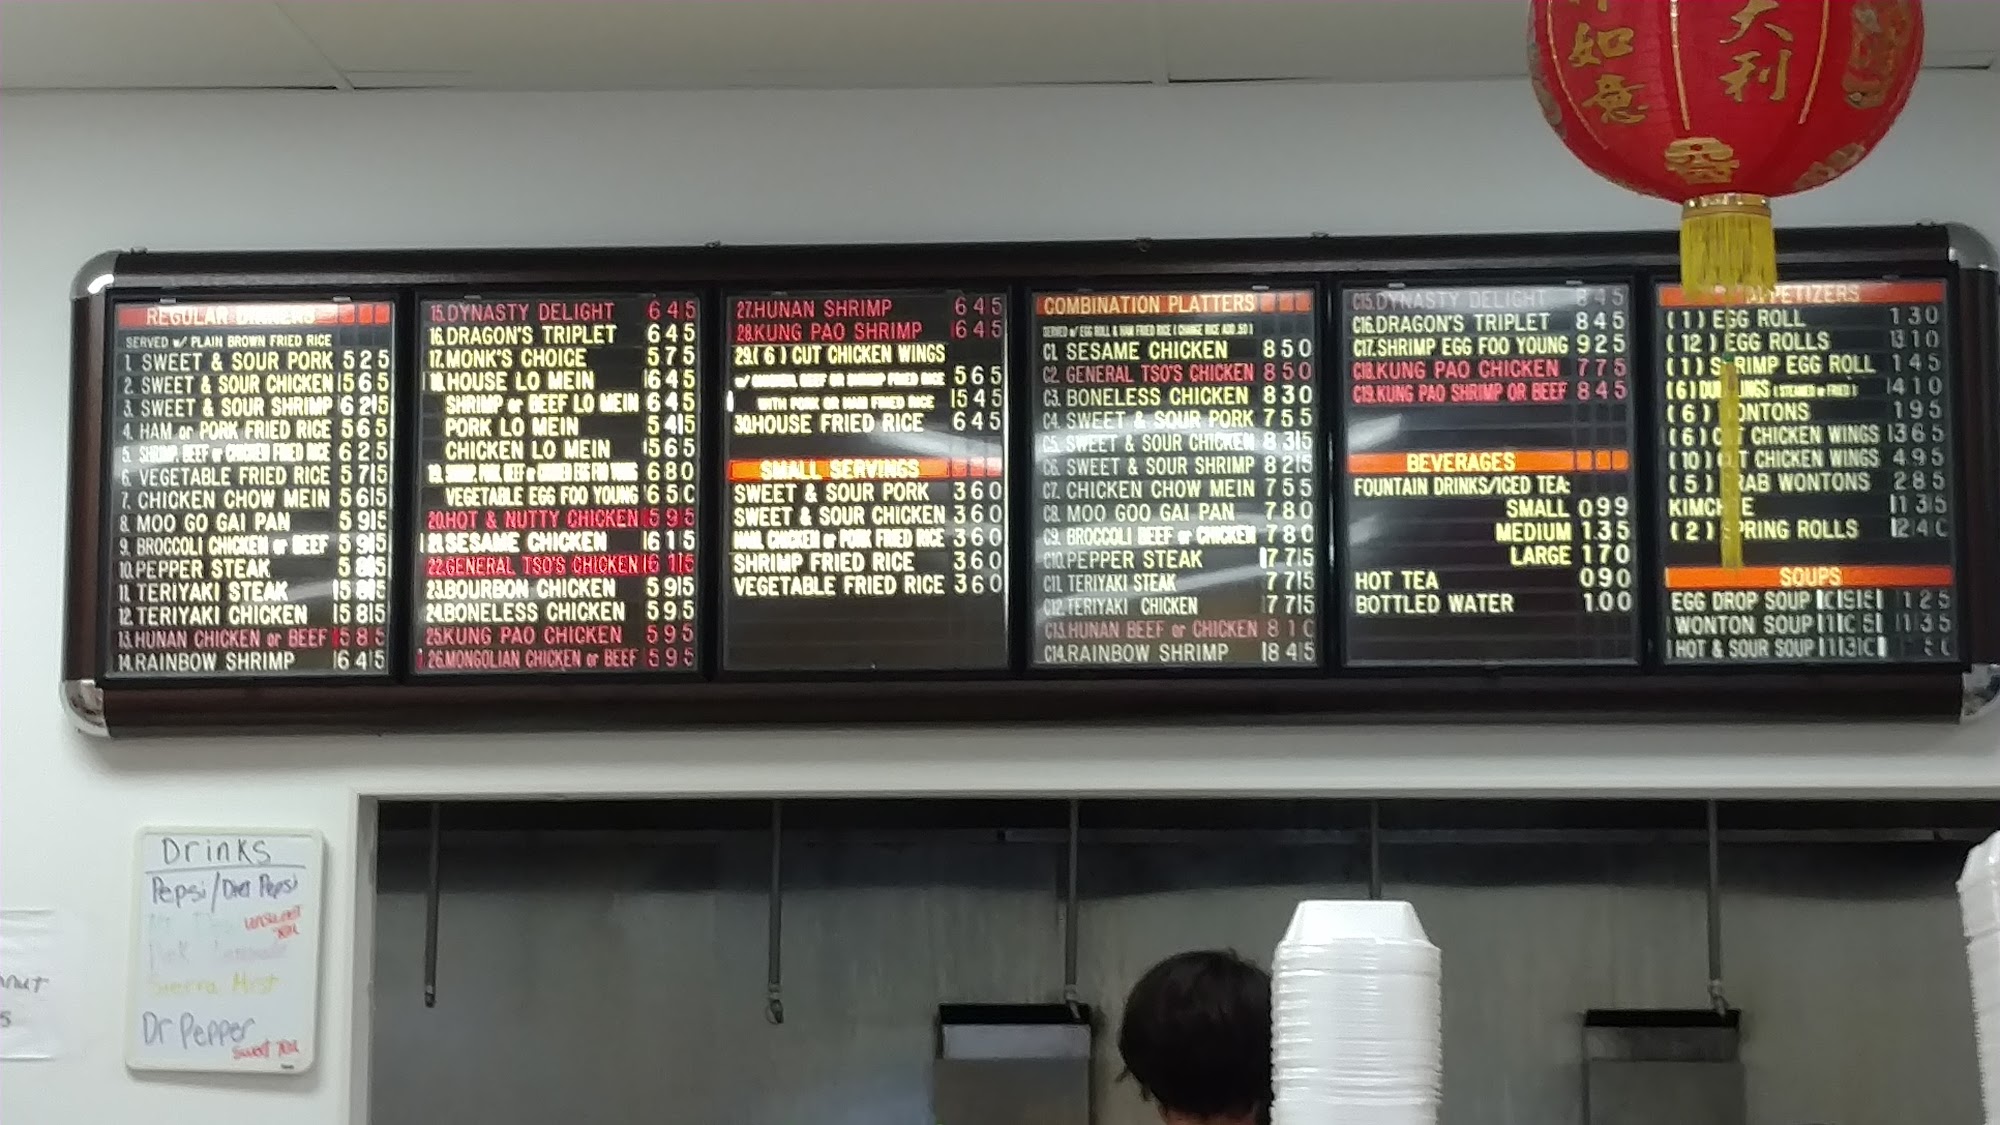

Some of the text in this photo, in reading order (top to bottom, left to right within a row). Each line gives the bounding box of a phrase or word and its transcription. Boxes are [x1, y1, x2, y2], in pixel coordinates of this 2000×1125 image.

[824, 300, 892, 317] SHRIMP
[1044, 296, 1255, 314] COMBINATION PLATTERS
[1470, 291, 1546, 308] DELIGHT
[539, 303, 615, 320] DELIGHT
[1713, 311, 1806, 327] EGG ROLL
[811, 322, 922, 341] PAO SHRIMP
[1475, 314, 1550, 331] TRIPLET
[126, 337, 168, 348] SERVED
[191, 336, 222, 347] PLAIN
[228, 336, 265, 347] BROWN
[270, 335, 302, 346] FRIED
[307, 334, 332, 346] RICE
[544, 326, 616, 344] TRIPLET
[1724, 333, 1830, 351] EGG ROLLS
[792, 344, 946, 364] CUT CHICKEN WINGS
[1067, 342, 1228, 360] SESAME CHICKEN
[1442, 336, 1568, 355] EGG FOO YOUNG
[142, 352, 333, 371] SWEET & SOUR PORK
[521, 349, 587, 367] CHOICE
[1787, 356, 1822, 375] EGG
[1829, 354, 1875, 373] ROLL
[1067, 363, 1254, 382] GENERAL TSO'S CHICKEN
[142, 374, 333, 394] SWEET & SOUR CHICKEN
[1419, 382, 1567, 402] PAO SHRIMP BEEF
[529, 395, 567, 413] BEEF
[574, 394, 594, 412] LO
[599, 394, 639, 412] MEIN
[1067, 388, 1248, 406] BONELESS CHICKEN
[1067, 410, 1254, 429] SWEET SOUR PORK
[140, 420, 332, 439] HAM PORK FRIED RICE
[446, 440, 610, 460] CHICKEN LO MEIN
[1755, 449, 1880, 468] CHICKEN WINGS
[760, 459, 920, 480] SMALL SERVINGS
[1406, 454, 1515, 471] BEVERAGES
[139, 466, 330, 486] VEGETABLE FRIED RICE
[1778, 472, 1870, 492] WONTONS
[446, 485, 639, 506] VEGETABLE EGG FOO YOUNG
[734, 482, 930, 503] SWEET & SOUR PORK
[1067, 480, 1255, 499] CHICKEN CHOW MEIN
[1354, 478, 1428, 496] FOUNTAIN
[1434, 477, 1530, 495] DRINKS/ICED
[138, 490, 330, 509] CHICKEN CHOW MEIN
[1507, 499, 1570, 517] SMALL
[506, 509, 638, 529] NUTTY CHICKEN
[1067, 503, 1234, 522] MOO GOO GAI PAN
[137, 513, 290, 533] MOO GO GAI PAN
[1496, 523, 1572, 542] MEDIUM
[1797, 520, 1859, 539] ROLLS
[137, 535, 329, 556] BROCCOLI CHICKEN BEEF
[1067, 527, 1256, 546] BROCCOLI BEEF CHICKEN
[734, 552, 914, 573] SHRIMP FRIED RICE
[1143, 551, 1202, 568] STEAK
[1511, 546, 1572, 565] LARGE
[211, 559, 270, 578] STEAK
[1779, 568, 1842, 587] SOUPS
[537, 579, 616, 598] CHICKEN
[734, 576, 945, 595] VEGETABLE FRIED RICE
[1069, 574, 1176, 592] TERIYAKI STEAK
[1355, 571, 1439, 590] HOT TEA
[229, 581, 288, 601] STEAK
[1356, 594, 1514, 613] BOTTLED WATER
[1671, 592, 1810, 611] EGG DROP SOUP
[229, 605, 307, 624] CHICKEN
[547, 602, 625, 621] CHICKEN
[1676, 615, 1814, 634] WONTON SOUP
[1159, 645, 1229, 661] SHRIMP
[1676, 639, 1814, 658] HOT SOUR SOUP
[226, 653, 295, 670] SHRIMP
[162, 837, 271, 865] Drinks
[142, 1012, 173, 1046] Dr
[180, 1012, 255, 1049] Pepper
